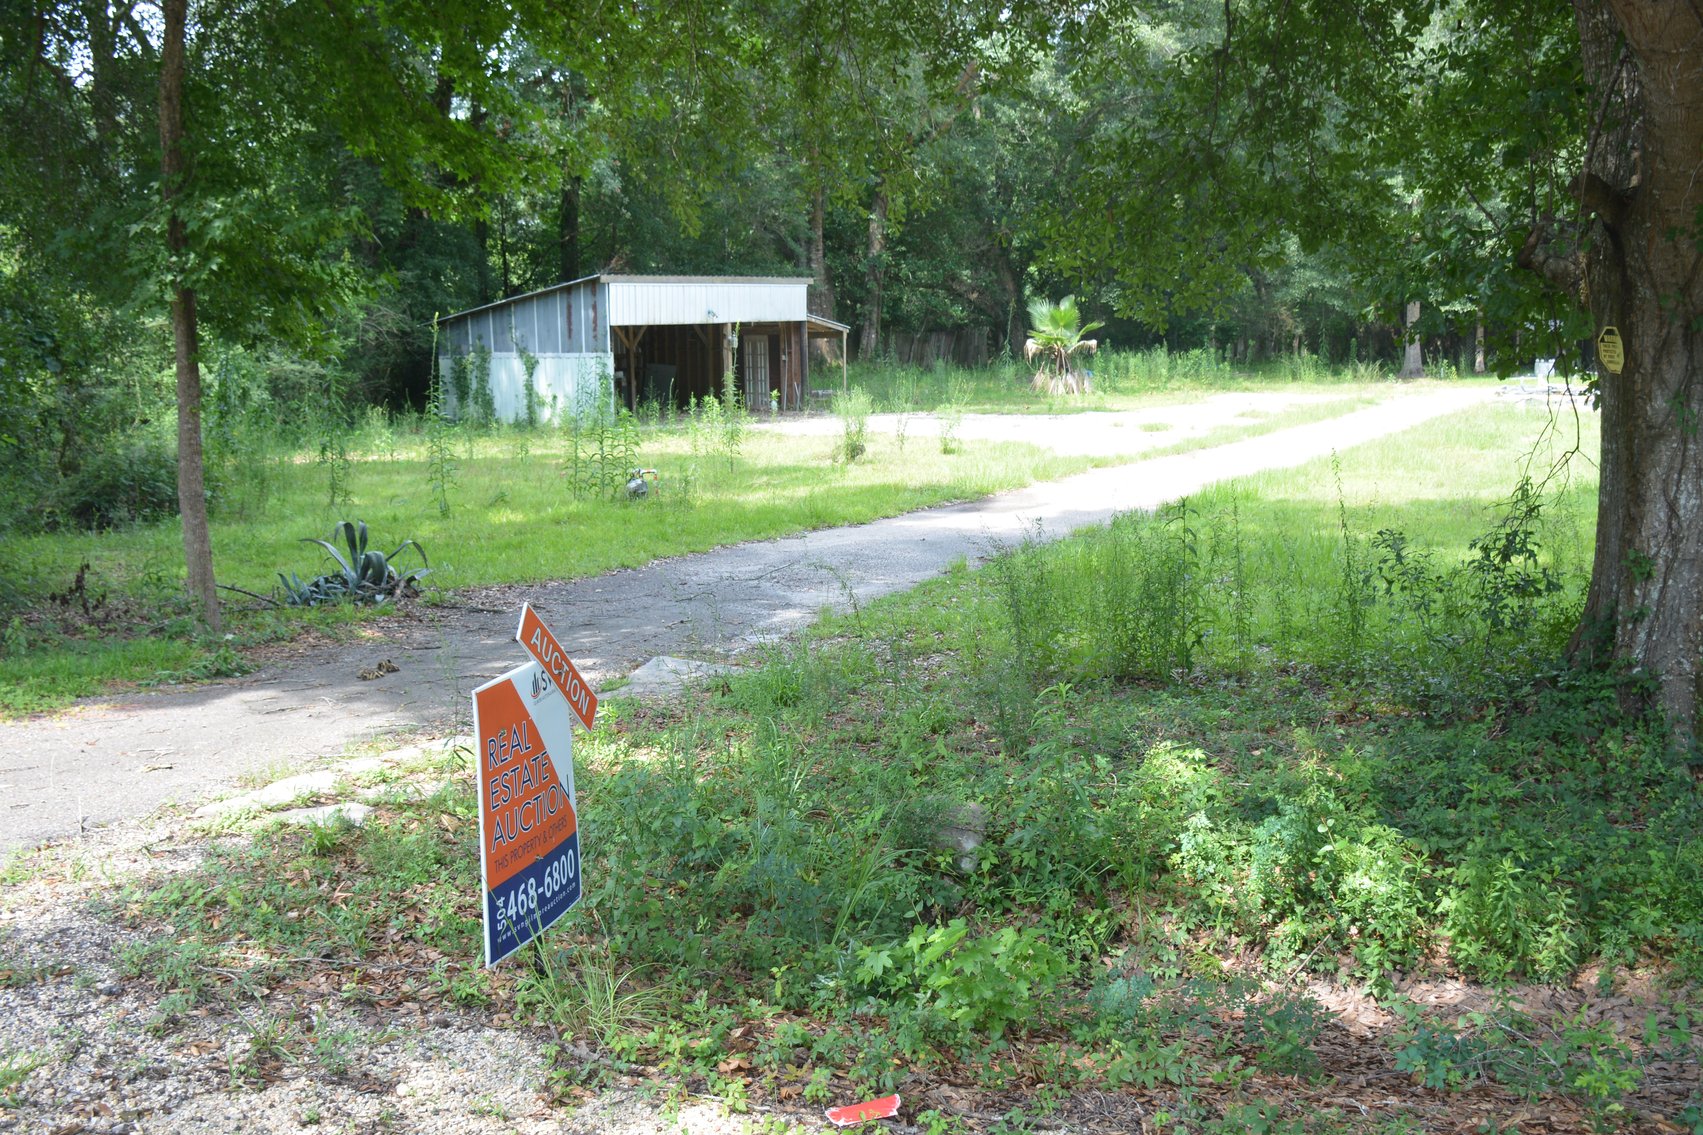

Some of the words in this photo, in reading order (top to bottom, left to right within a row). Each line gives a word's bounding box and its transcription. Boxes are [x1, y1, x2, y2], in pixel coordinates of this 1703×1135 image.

[530, 627, 590, 716] AUCTION
[488, 720, 532, 770] REAL
[489, 750, 550, 812] ESTATE
[491, 774, 571, 853] AUCTION
[494, 854, 509, 873] THIS
[510, 833, 542, 863] PROPERTY
[543, 831, 548, 843] &
[549, 815, 568, 838] OTHERS
[507, 849, 575, 921] 468-6800
